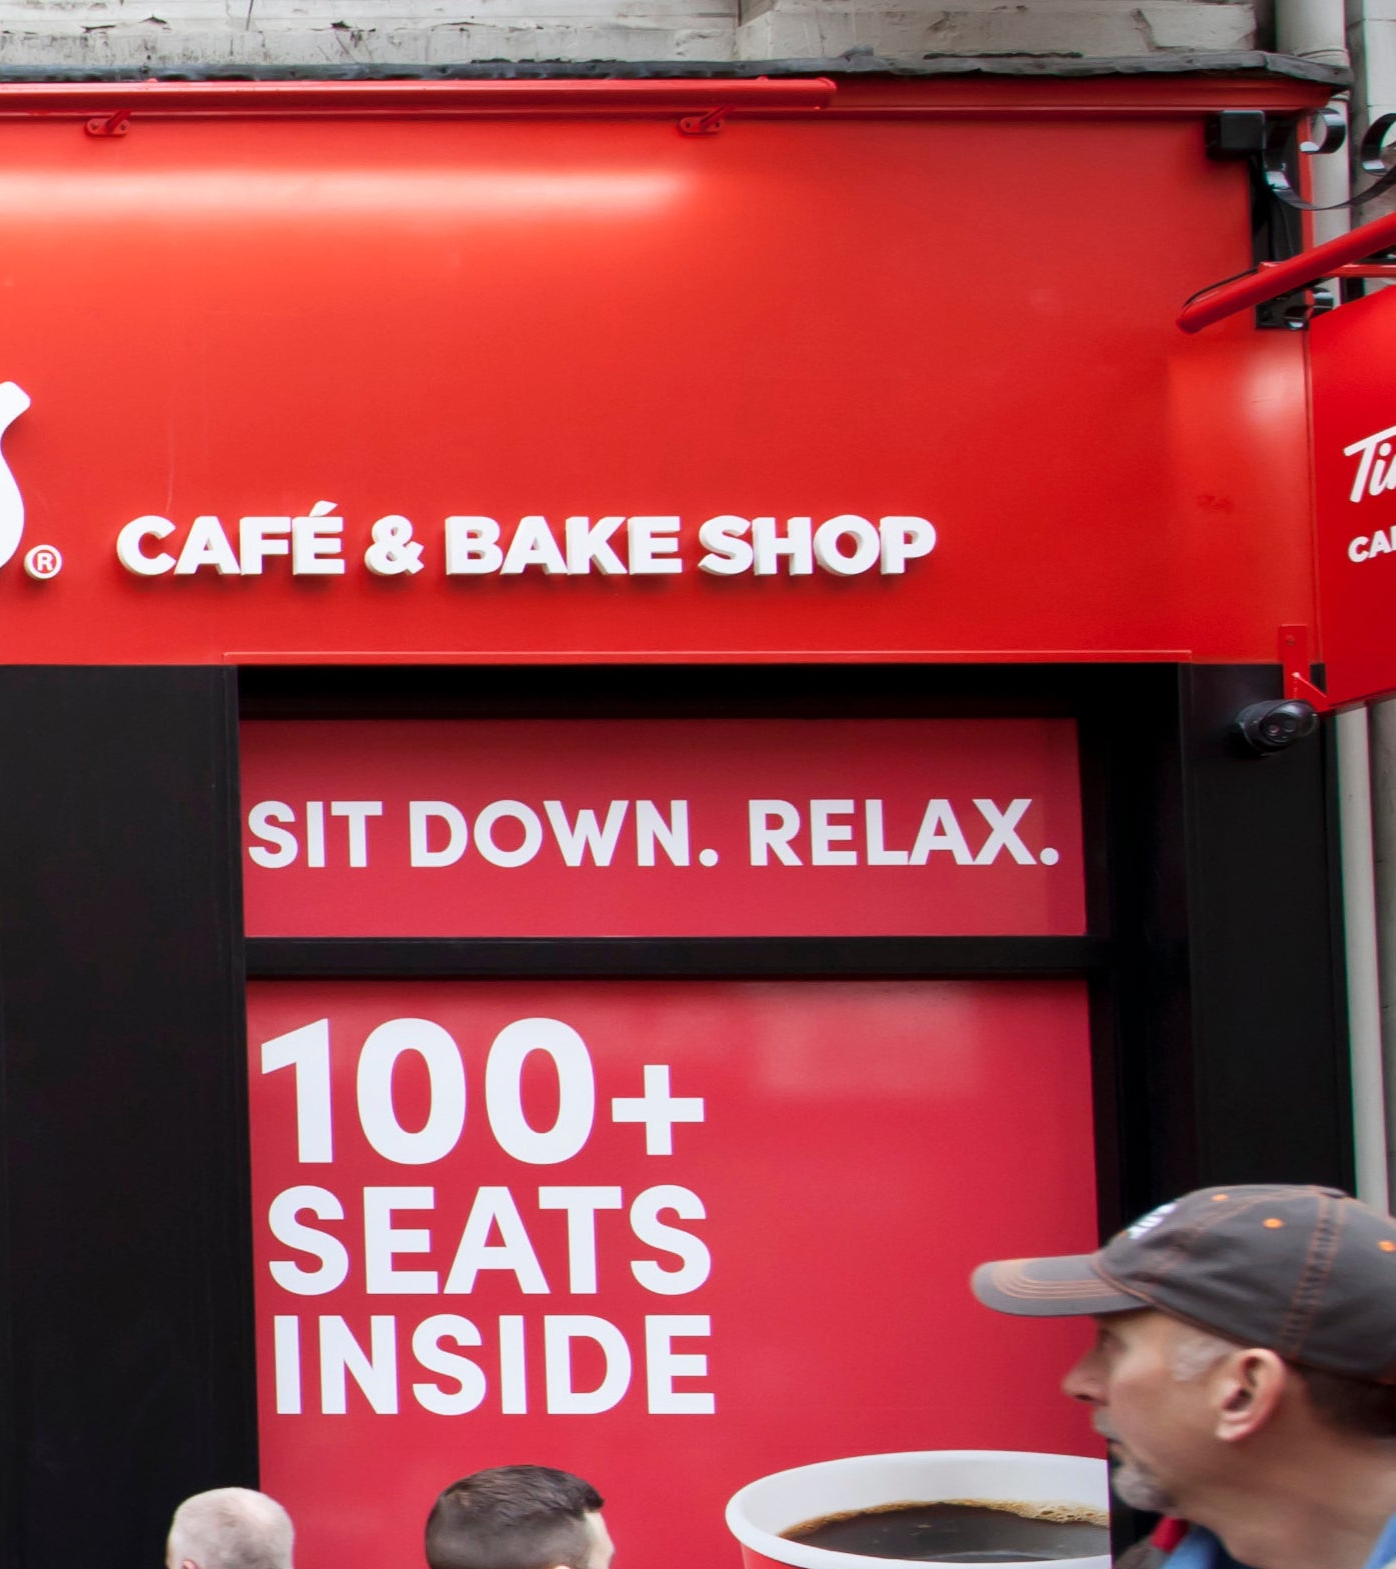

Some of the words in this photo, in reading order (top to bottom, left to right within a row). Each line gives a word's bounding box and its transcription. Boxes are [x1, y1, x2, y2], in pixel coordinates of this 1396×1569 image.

[1344, 426, 1396, 502] Ti
[117, 501, 345, 575] CAFÉ
[365, 515, 423, 574] &
[446, 516, 682, 574] BAKE
[699, 515, 935, 574] SHOP
[249, 801, 382, 868] SIT
[410, 800, 718, 867] DOWN.
[749, 799, 1058, 865] RELAX.
[261, 1018, 704, 1164] 100+
[269, 1185, 710, 1295] SEATS
[275, 1314, 714, 1415] INSIDE
